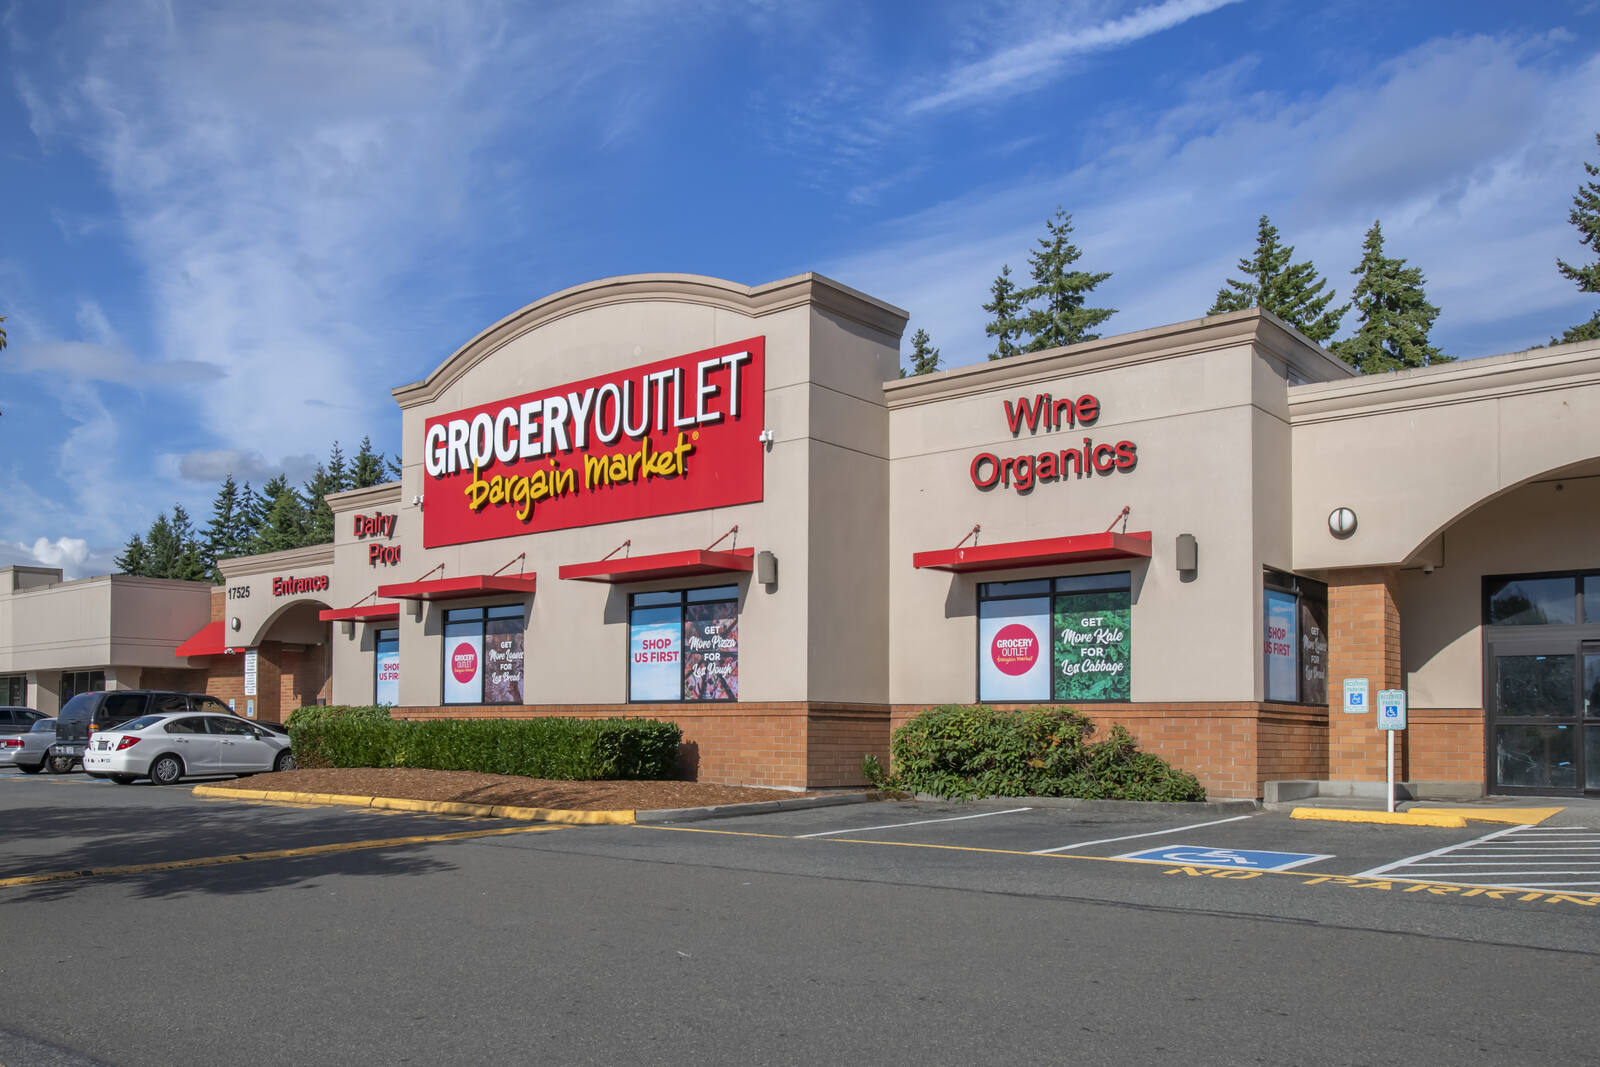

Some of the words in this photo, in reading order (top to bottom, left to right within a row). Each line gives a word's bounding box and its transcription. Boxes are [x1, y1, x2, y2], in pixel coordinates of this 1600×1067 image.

[1003, 393, 1098, 433] Wine
[970, 437, 1136, 491] Organics
[465, 458, 576, 521] bargain
[353, 512, 395, 538] Dairy
[272, 575, 328, 595] Entrance
[228, 586, 250, 600] 17525
[1081, 617, 1104, 627] GET
[705, 626, 720, 634] GET
[1061, 628, 1093, 646] More
[1094, 627, 1123, 645] Kale
[1268, 626, 1286, 640] SHOP
[642, 638, 671, 650] SHOP
[689, 635, 711, 651] More
[996, 638, 1034, 648] GROCERY
[1273, 642, 1290, 656] FIRST
[634, 652, 648, 663] US
[650, 651, 679, 662] FIRST
[704, 653, 721, 661] FOR
[1001, 647, 1028, 656] OUTLET
[1081, 647, 1104, 657] FOR
[1060, 659, 1081, 676] Less
[1081, 658, 1124, 676] Cabbage
[379, 672, 387, 680] US
[1162, 866, 1263, 879] NO
